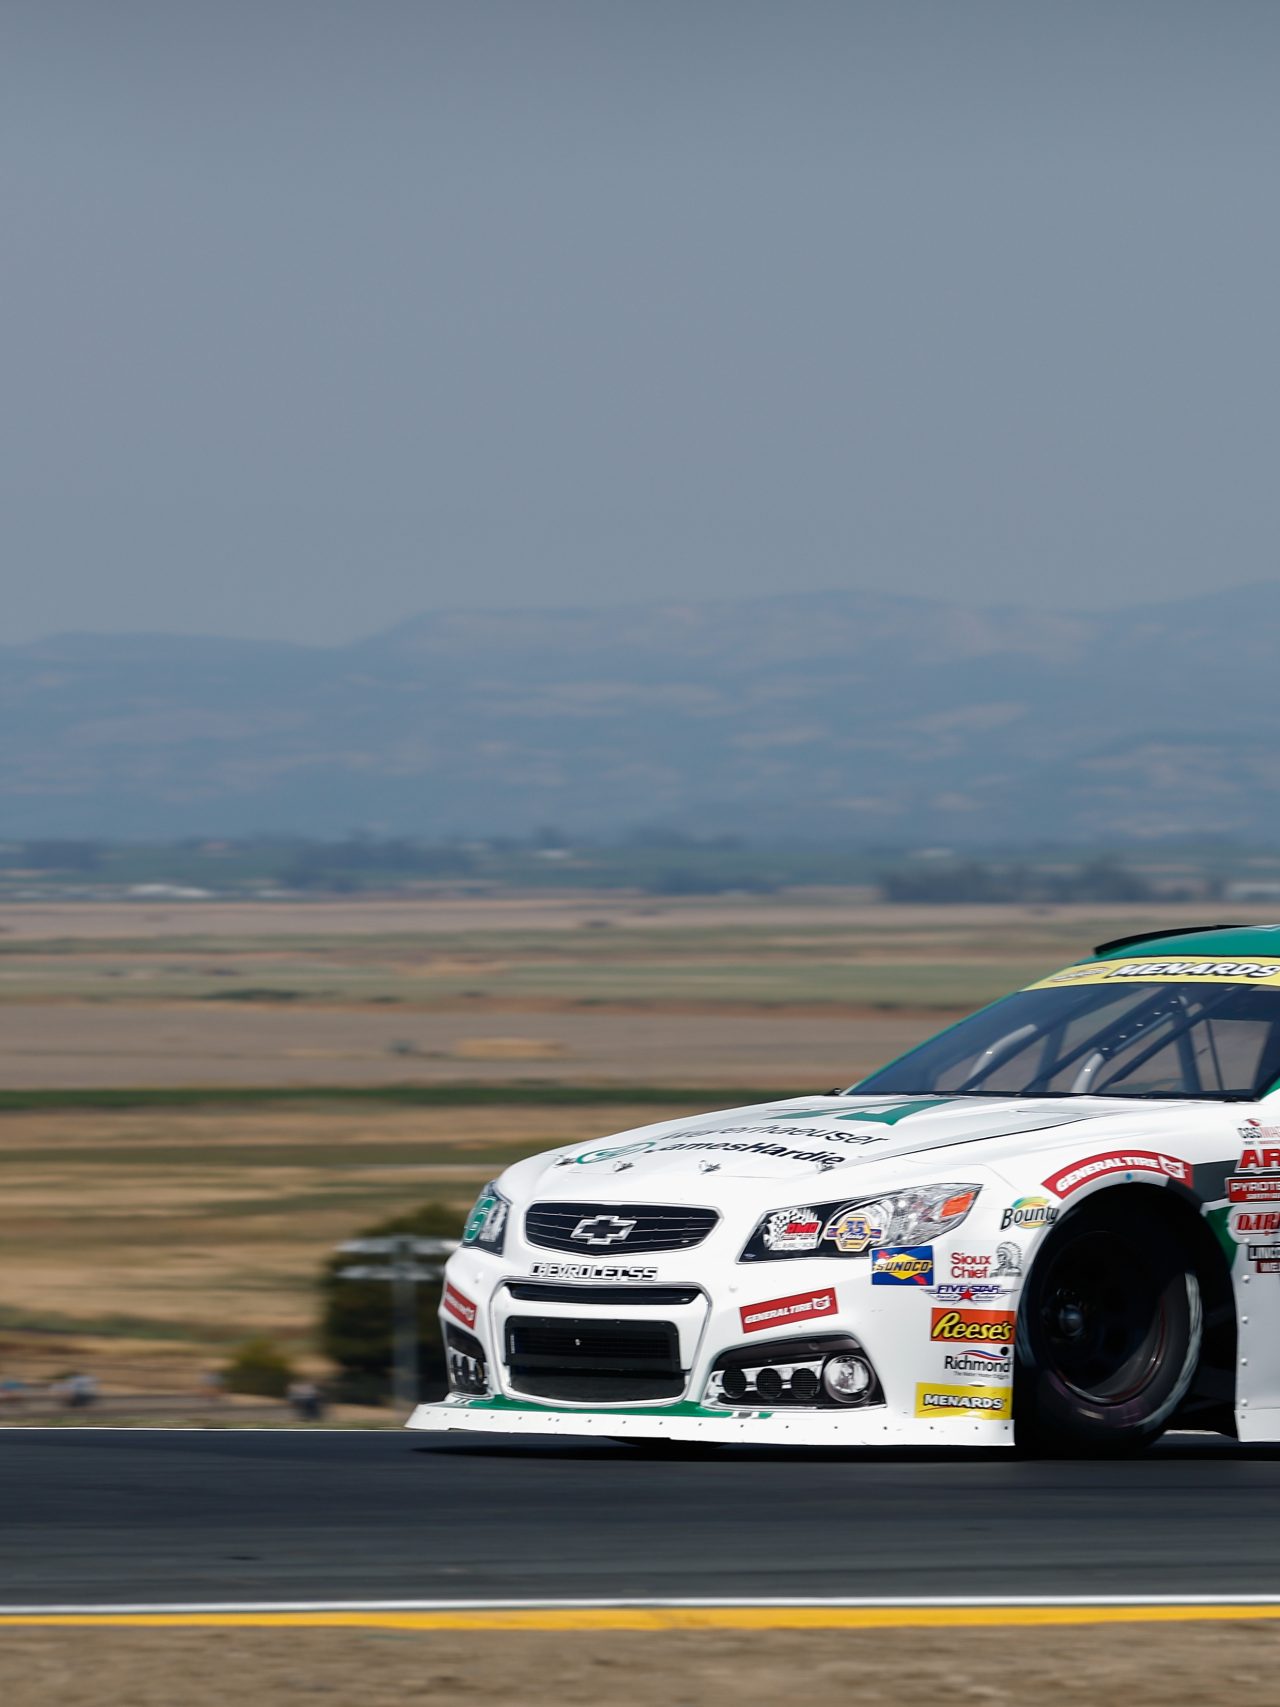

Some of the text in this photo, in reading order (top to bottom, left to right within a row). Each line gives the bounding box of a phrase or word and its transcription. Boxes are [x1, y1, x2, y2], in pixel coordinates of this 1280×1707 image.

[1055, 1157, 1125, 1192] GENERAL
[1124, 1156, 1160, 1169] TIRE
[1000, 1205, 1060, 1231] Bounty
[876, 1260, 931, 1273] SUNOCO
[951, 1252, 992, 1266] Sioux
[951, 1266, 990, 1278] Chief
[937, 1285, 1001, 1294] FIVE STAR
[744, 1308, 791, 1324] GENERAL
[789, 1301, 813, 1313] TIRE
[931, 1312, 1014, 1341] Reese's
[944, 1354, 1011, 1373] Richmond
[923, 1393, 1004, 1410] MENARDS
